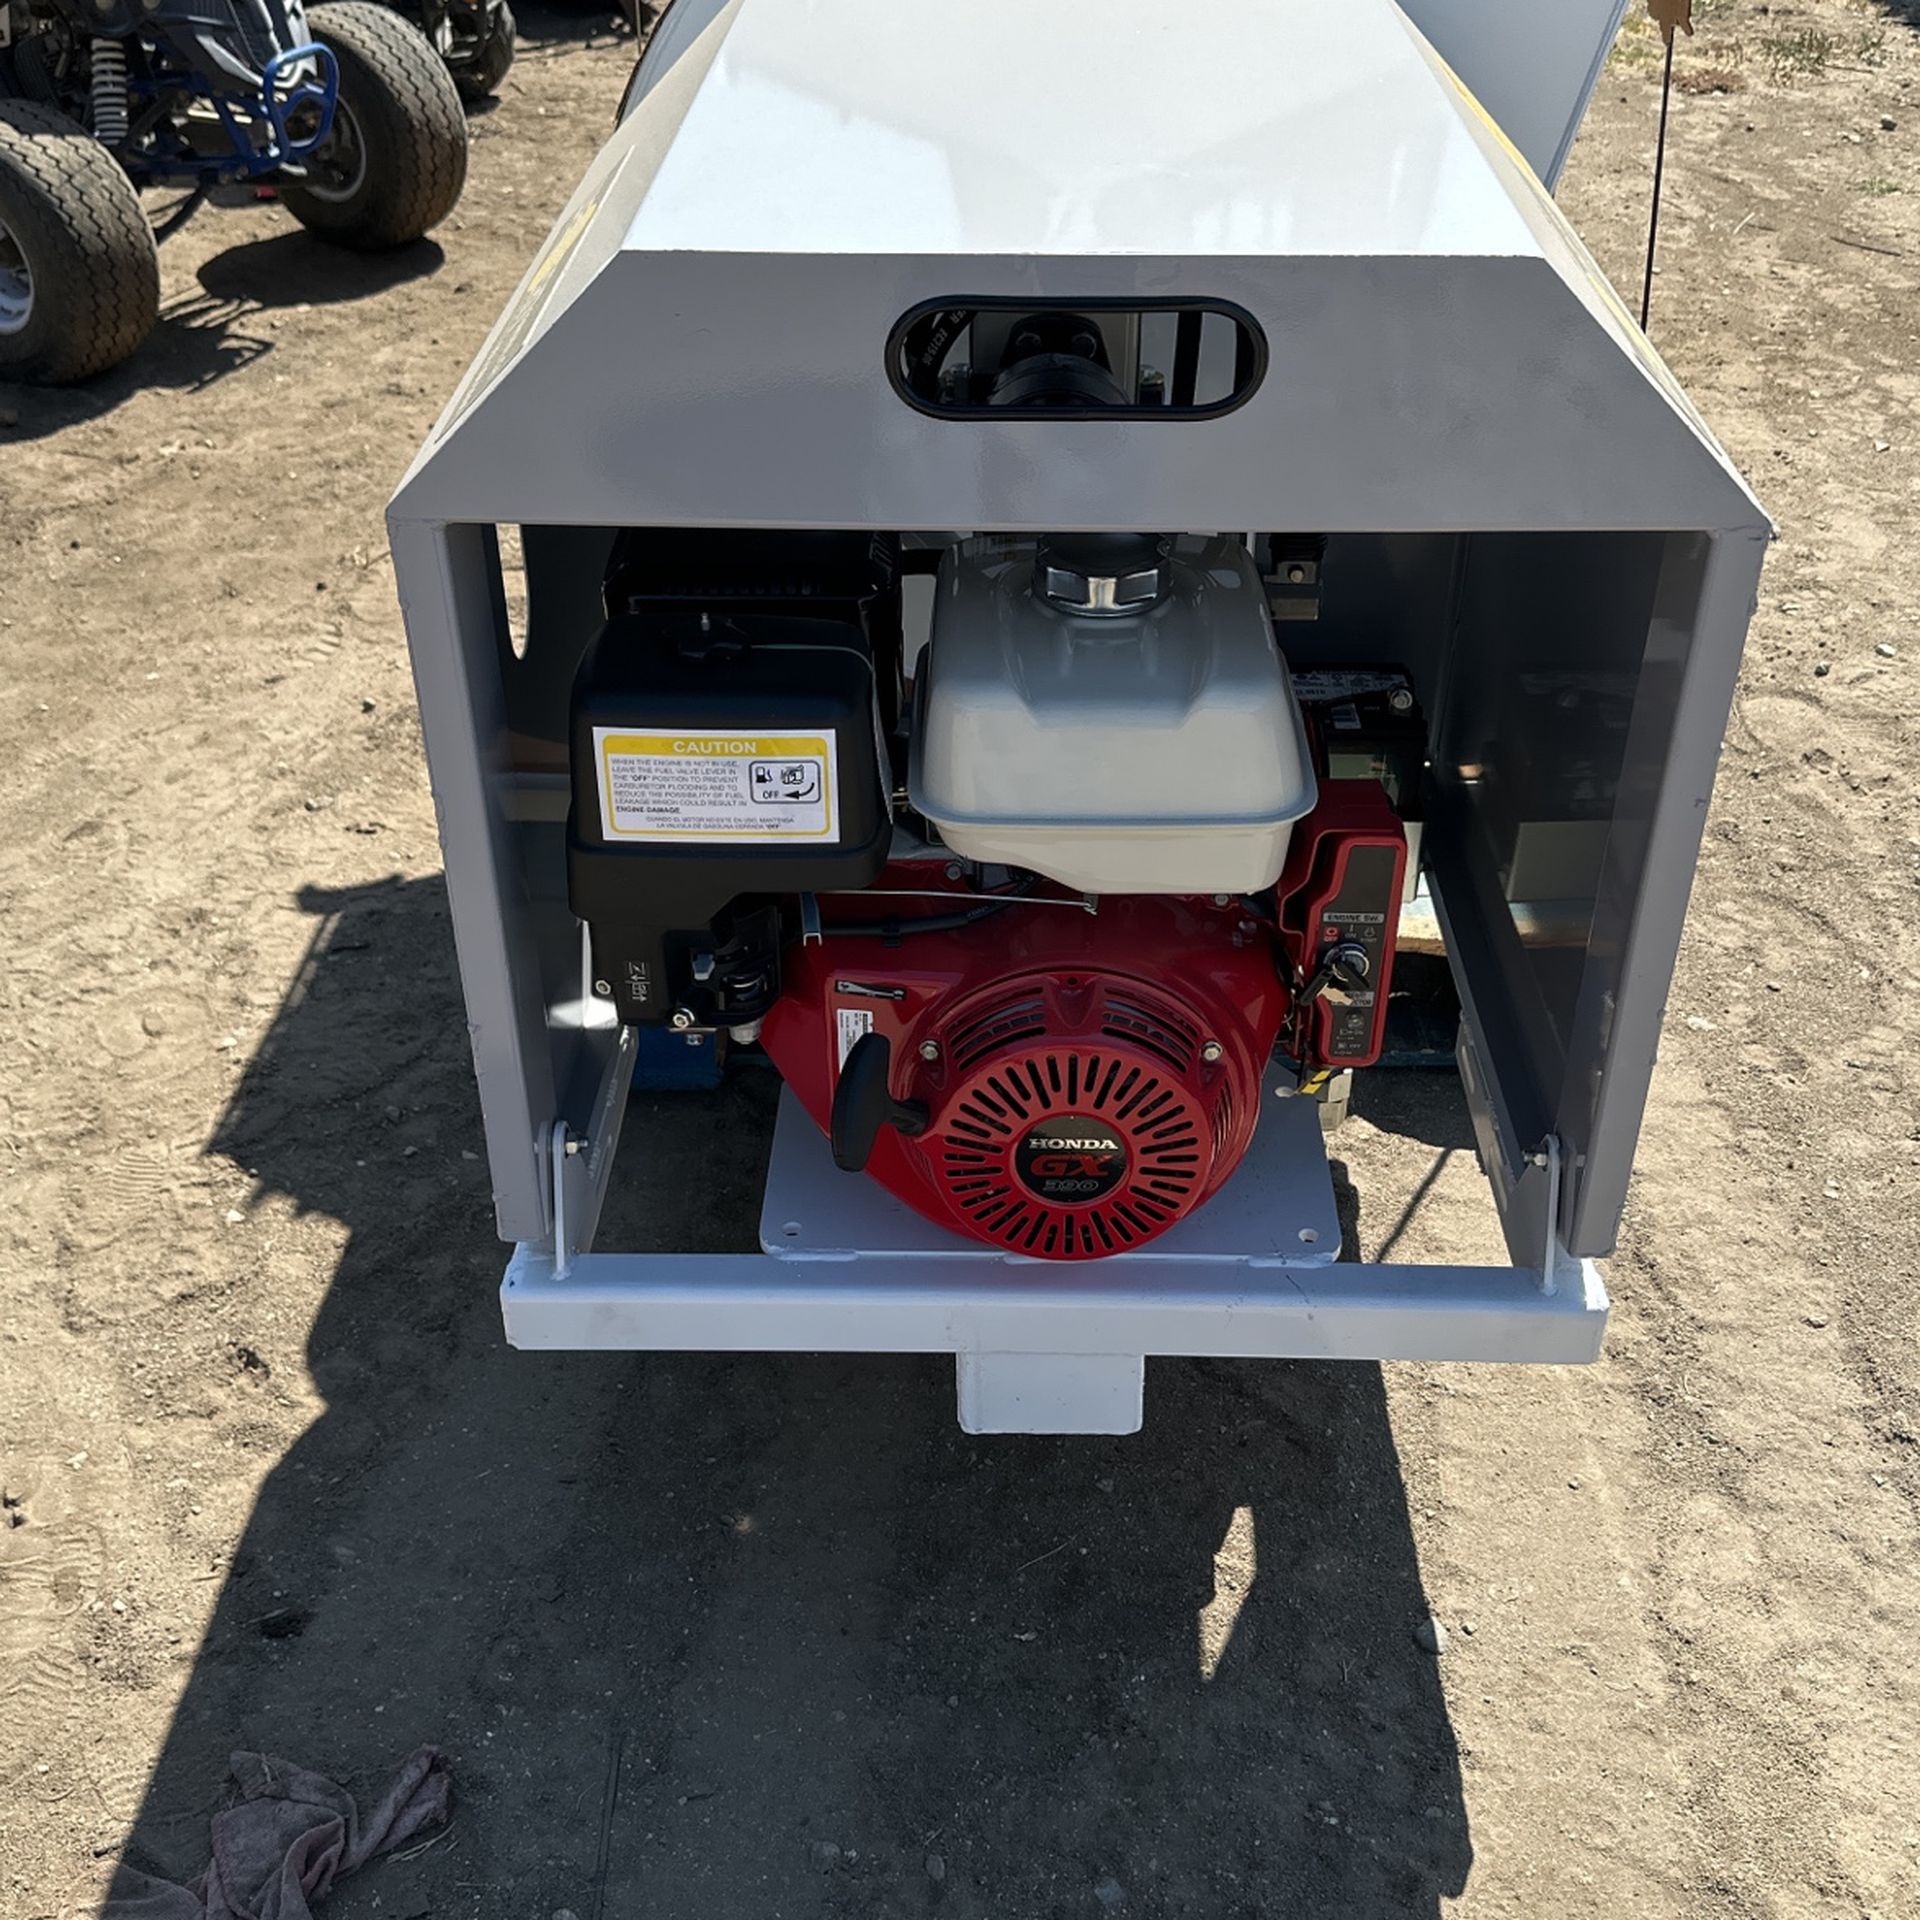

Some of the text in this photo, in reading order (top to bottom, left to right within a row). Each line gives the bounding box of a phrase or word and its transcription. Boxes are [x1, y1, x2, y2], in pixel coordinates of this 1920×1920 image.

[672, 741, 757, 754] CAUTION
[763, 791, 780, 800] OFF
[1327, 914, 1361, 922] ENGINE
[1029, 1138, 1118, 1150] HONDA
[1030, 1153, 1113, 1177] GX
